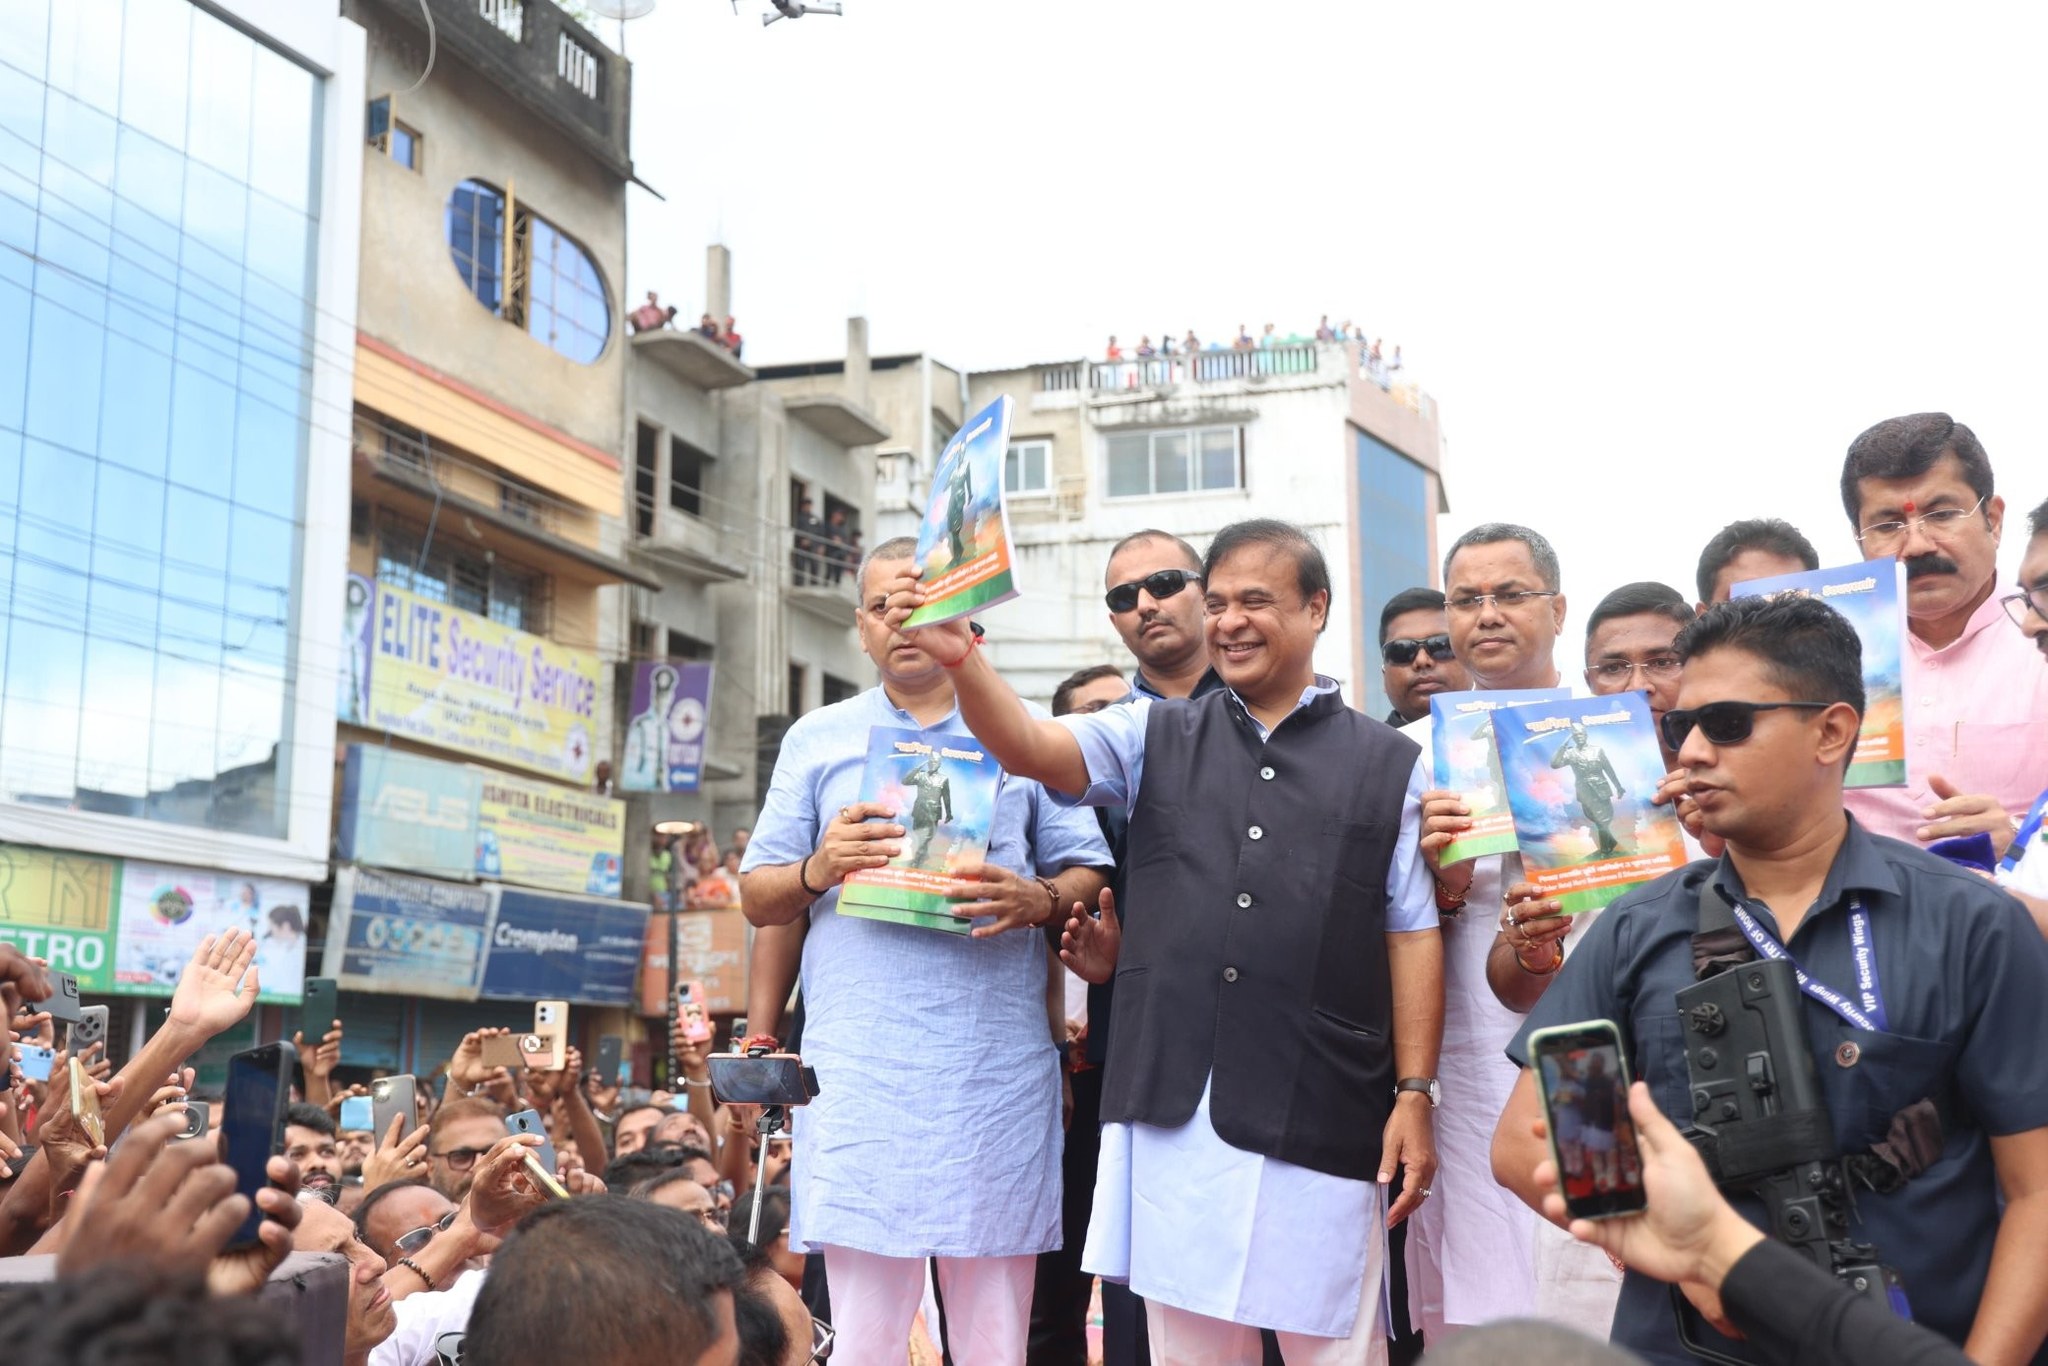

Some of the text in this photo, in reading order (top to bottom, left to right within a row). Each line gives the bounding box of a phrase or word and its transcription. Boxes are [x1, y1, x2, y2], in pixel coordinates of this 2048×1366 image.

[1822, 577, 1876, 597] Souvenir
[379, 591, 442, 670] ELITE
[446, 617, 525, 709] Security
[530, 645, 595, 719] Service
[1733, 903, 1754, 932] HOME
[1852, 914, 1865, 946] Wings
[494, 921, 579, 956] Crompton
[1750, 929, 1764, 943] OF
[1856, 947, 1872, 990] Security
[1808, 984, 1841, 1005] Wings
[1862, 992, 1877, 1013] VIP
